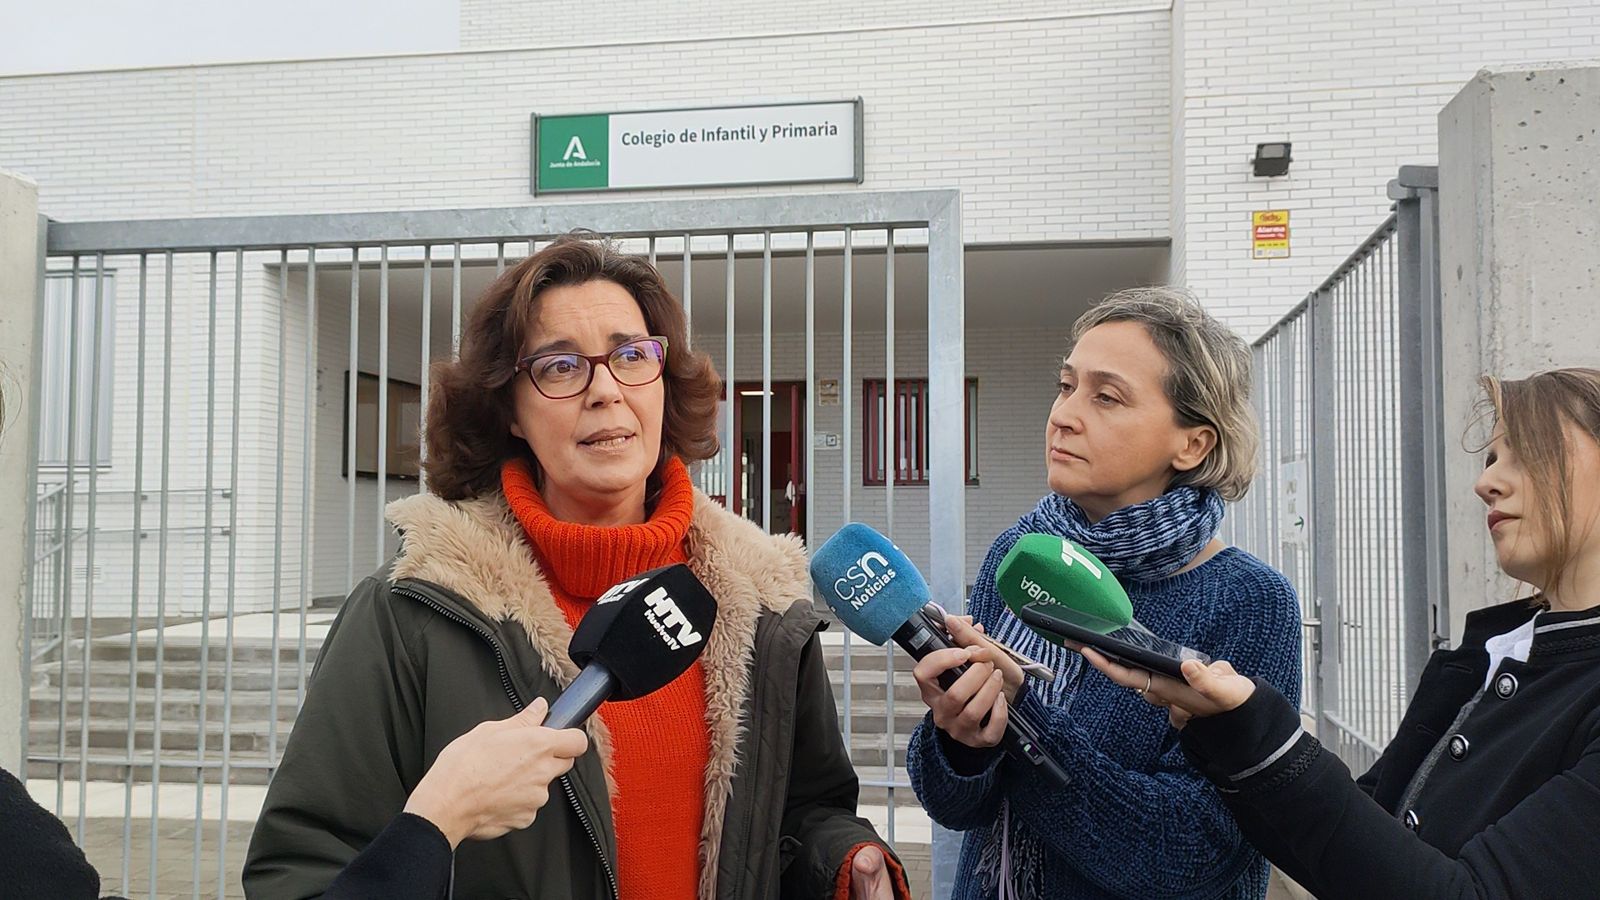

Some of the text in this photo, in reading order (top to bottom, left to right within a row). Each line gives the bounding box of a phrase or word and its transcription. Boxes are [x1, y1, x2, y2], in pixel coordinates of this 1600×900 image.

[621, 121, 838, 148] Colegio de Infantil y Primaria
[850, 568, 897, 611] Noticias
[644, 586, 703, 647] HTV
[644, 609, 681, 651] HuelvaTV
